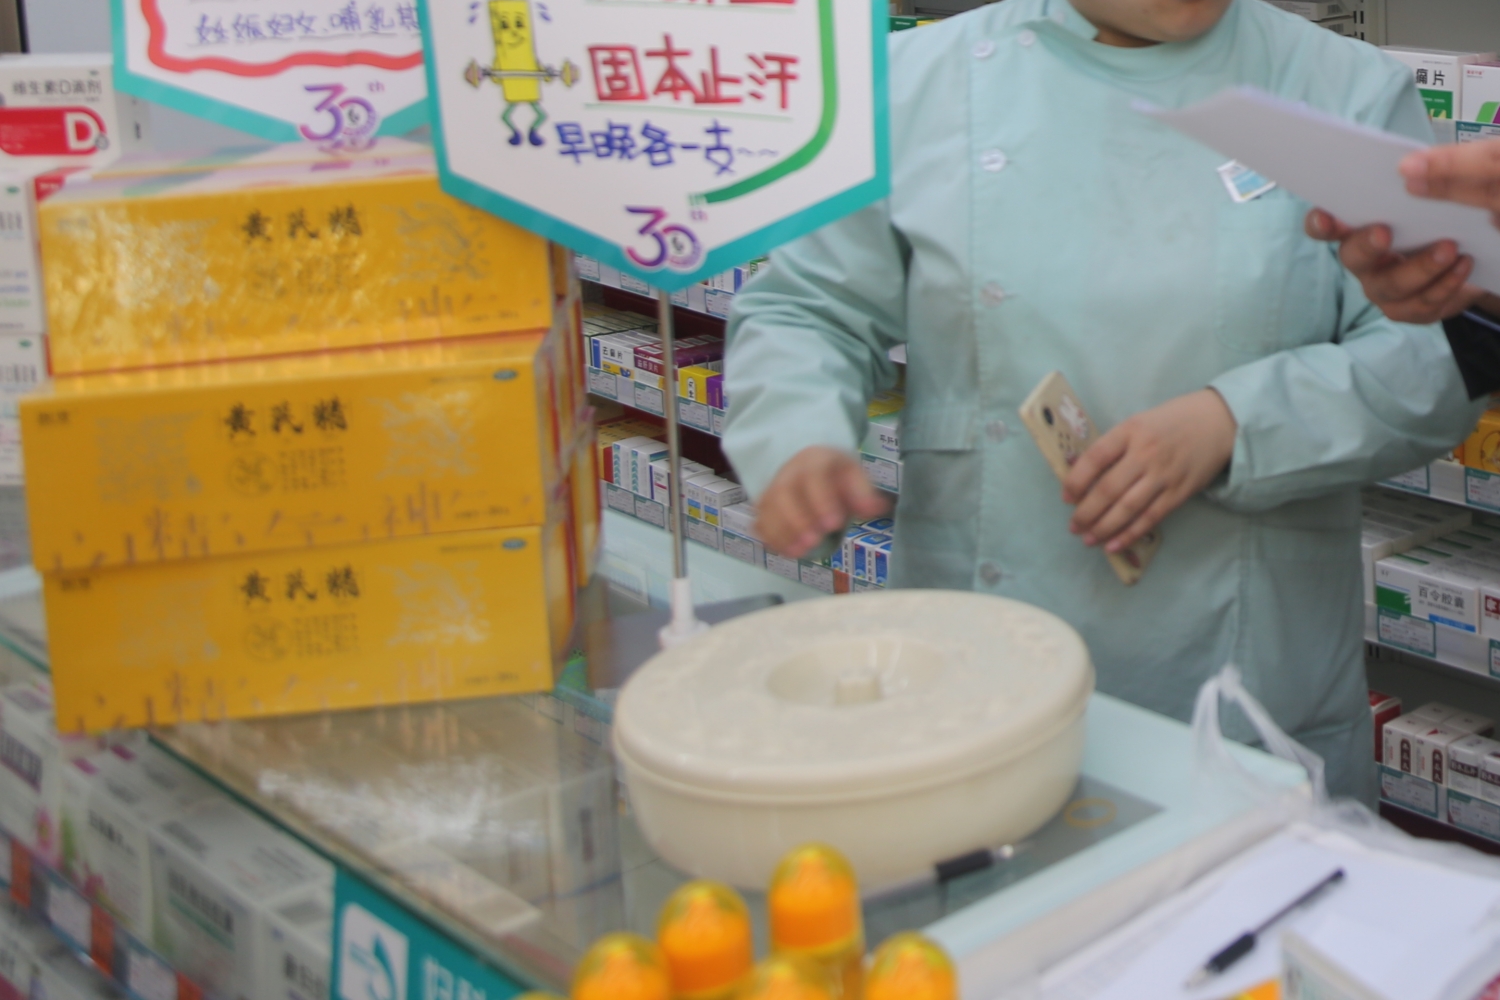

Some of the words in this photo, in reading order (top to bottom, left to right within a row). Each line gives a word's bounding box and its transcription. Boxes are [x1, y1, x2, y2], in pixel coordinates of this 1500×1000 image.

[587, 33, 799, 110] 固本止汗
[1418, 585, 1465, 610] 百令胶囊
